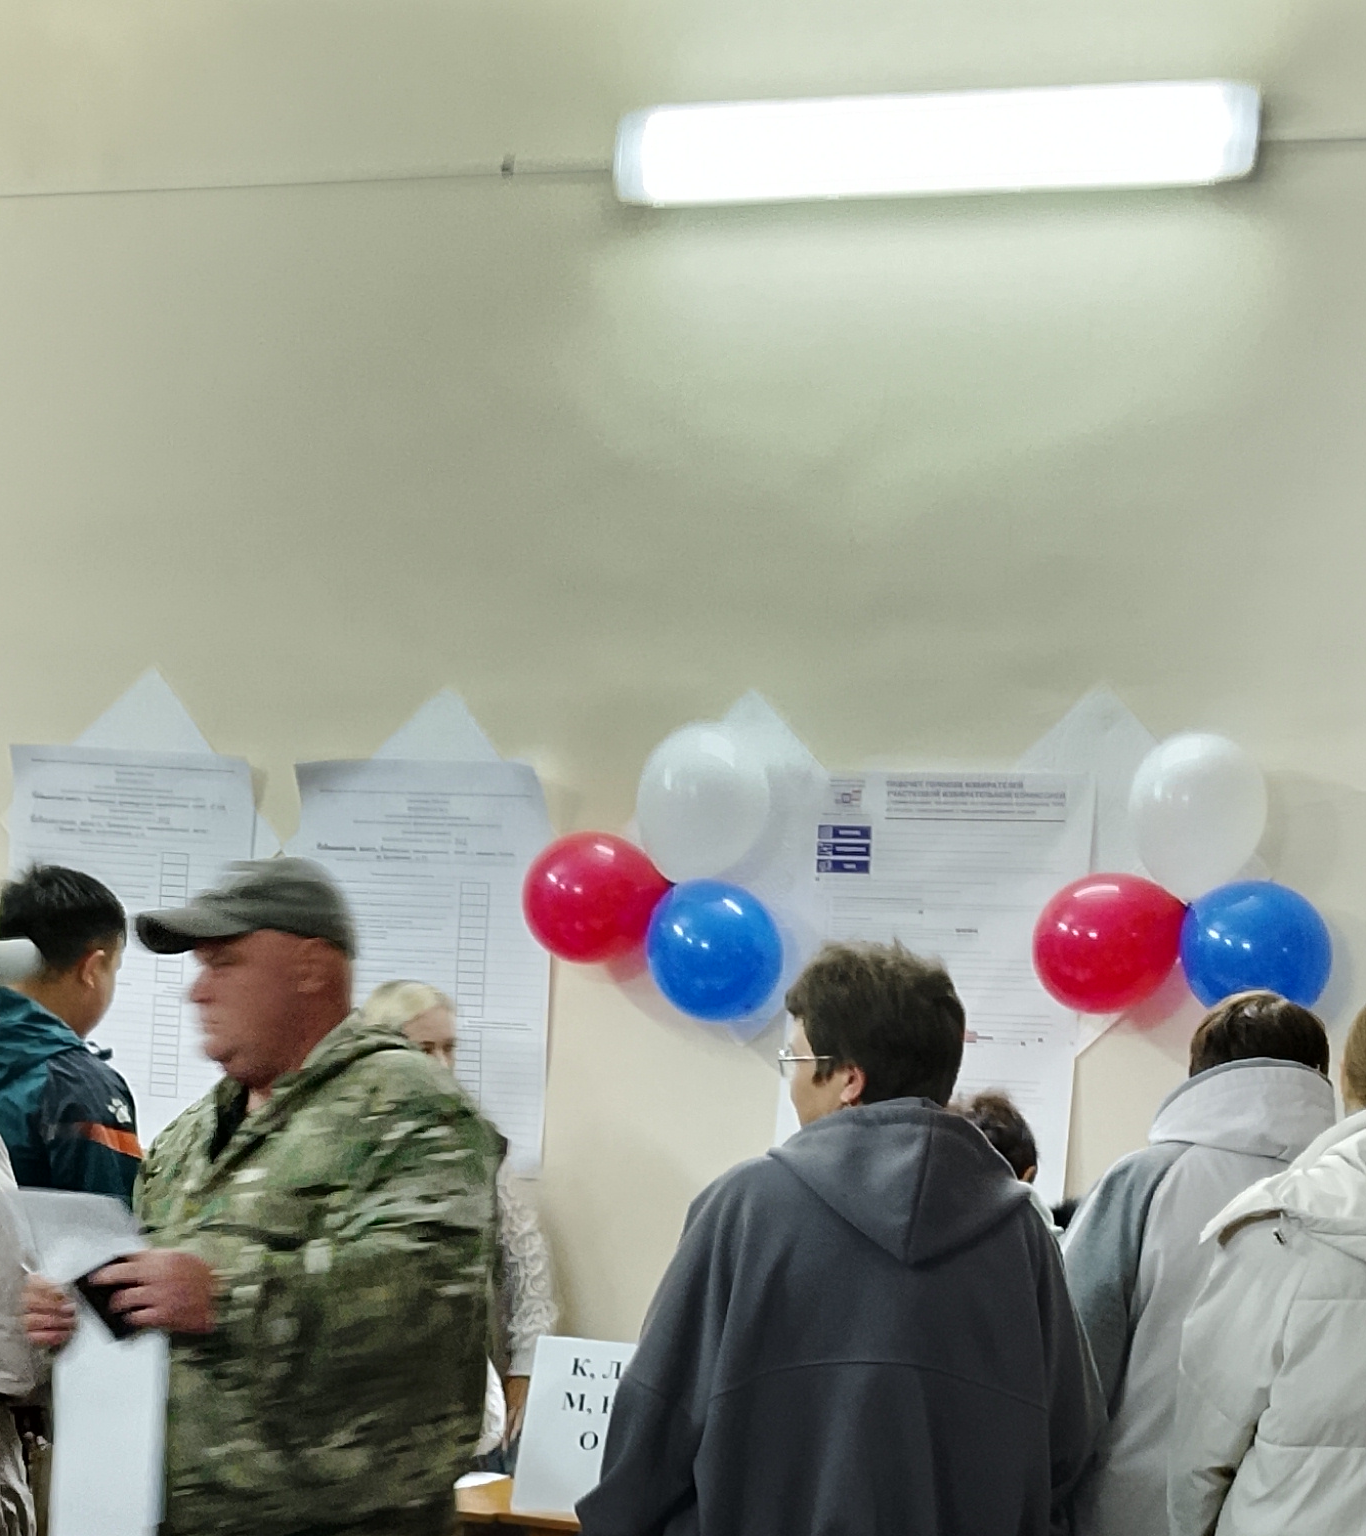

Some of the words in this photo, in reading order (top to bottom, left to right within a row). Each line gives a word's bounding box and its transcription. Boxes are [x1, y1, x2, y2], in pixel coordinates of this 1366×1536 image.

[571, 1357, 596, 1380] К,
[561, 1391, 592, 1414] М,
[579, 1430, 599, 1451] О
